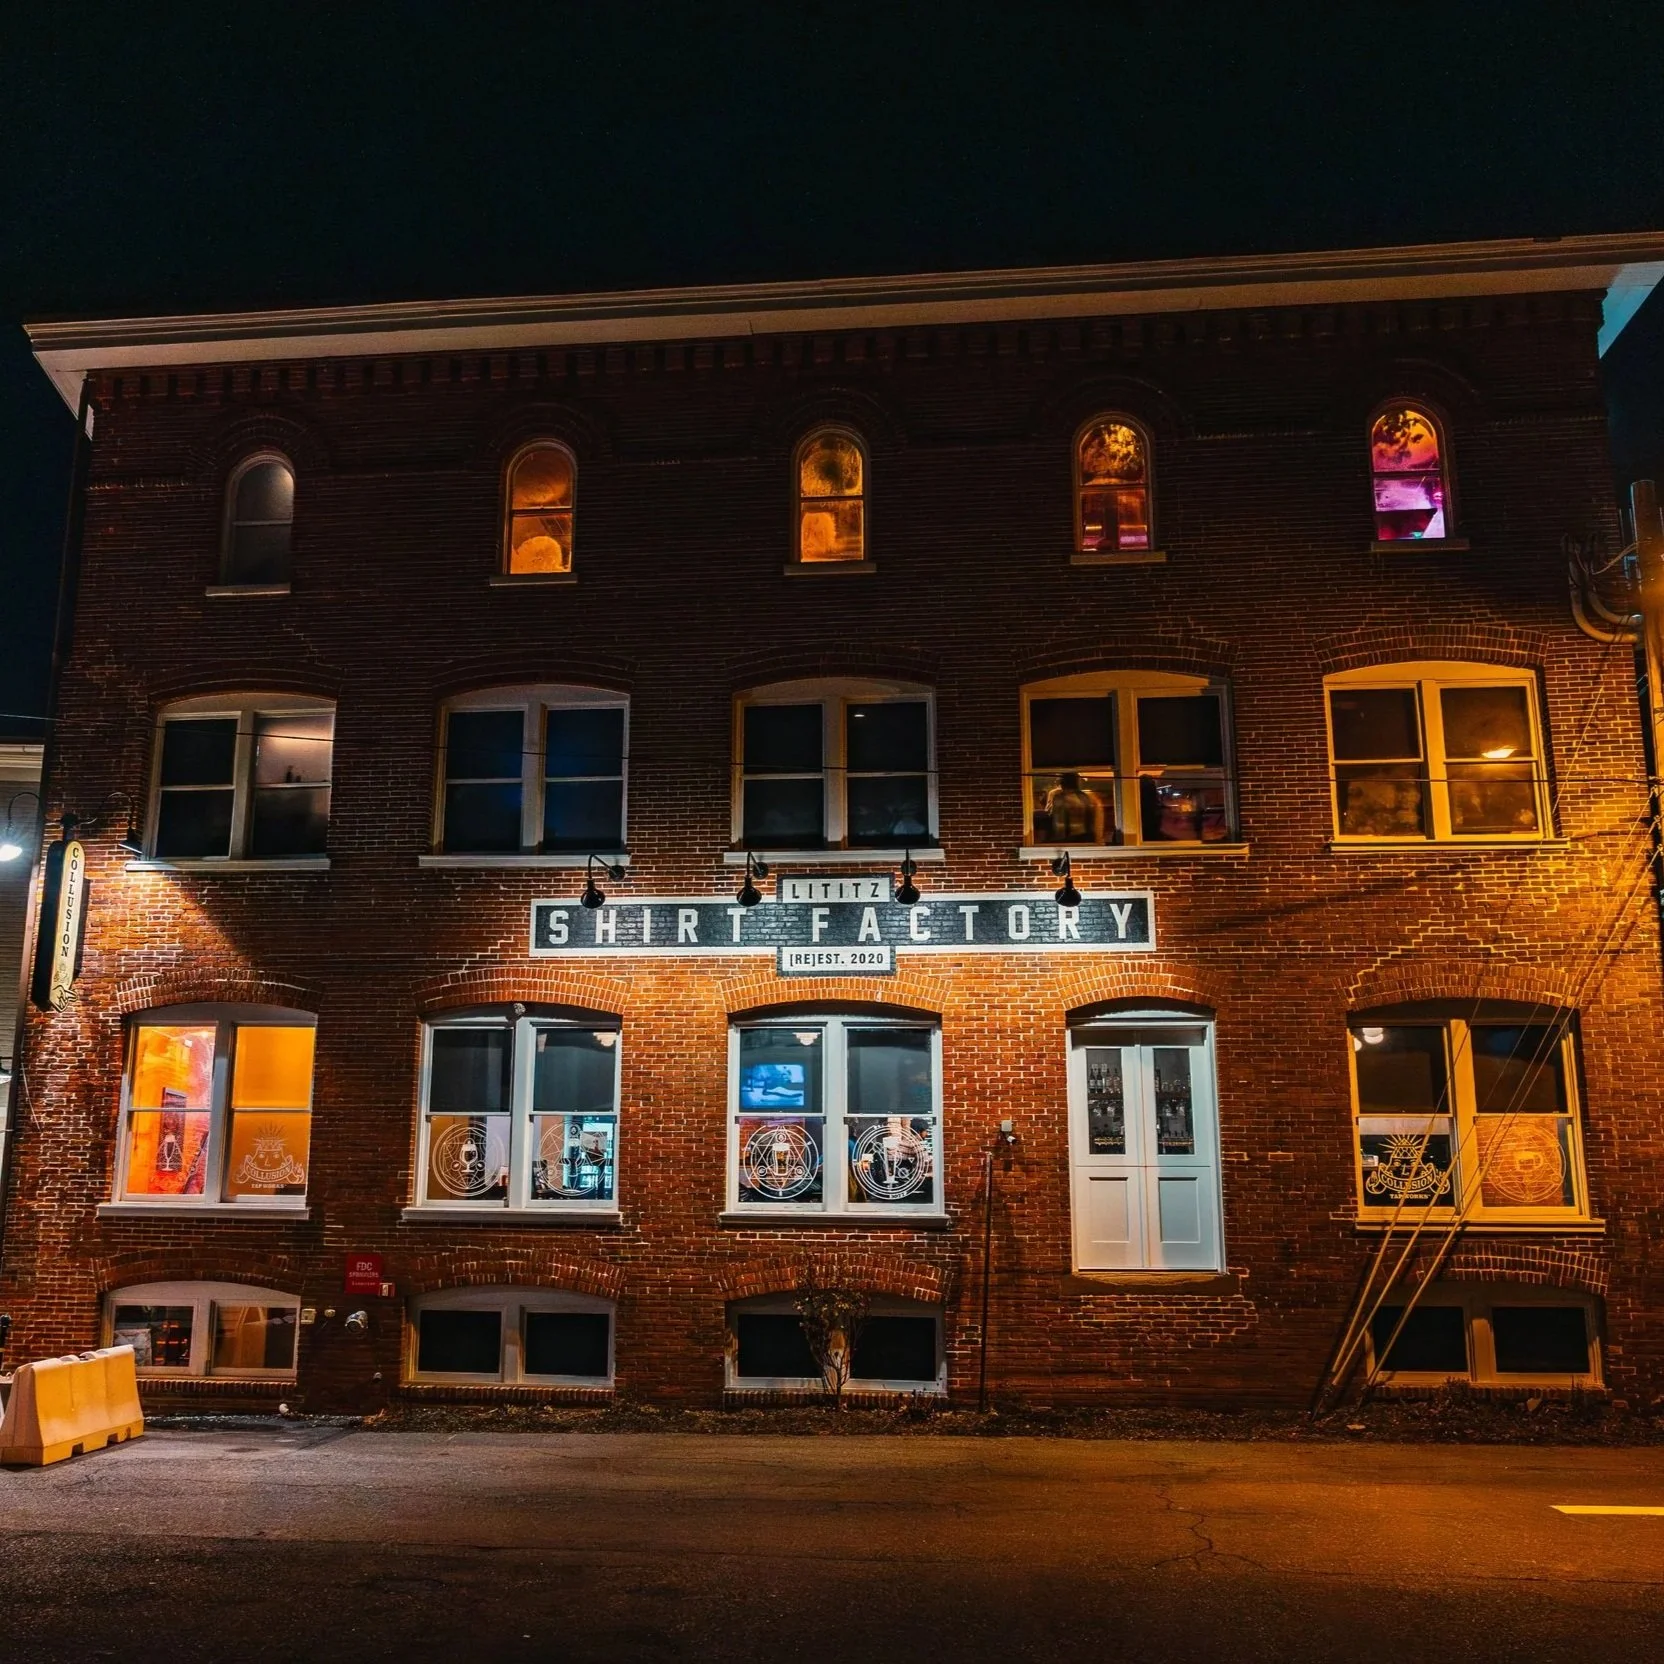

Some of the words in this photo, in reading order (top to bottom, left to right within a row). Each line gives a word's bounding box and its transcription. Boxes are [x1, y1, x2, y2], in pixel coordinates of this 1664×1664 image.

[792, 883, 880, 899] LITITZ
[60, 847, 79, 957] COLLUSION
[548, 908, 747, 945] SHIRT
[811, 903, 1133, 943] FACTORY
[790, 953, 845, 967] [RE]EST.
[850, 953, 884, 964] 2020
[245, 1165, 291, 1180] COLLUSION
[356, 1261, 373, 1271] FDC
